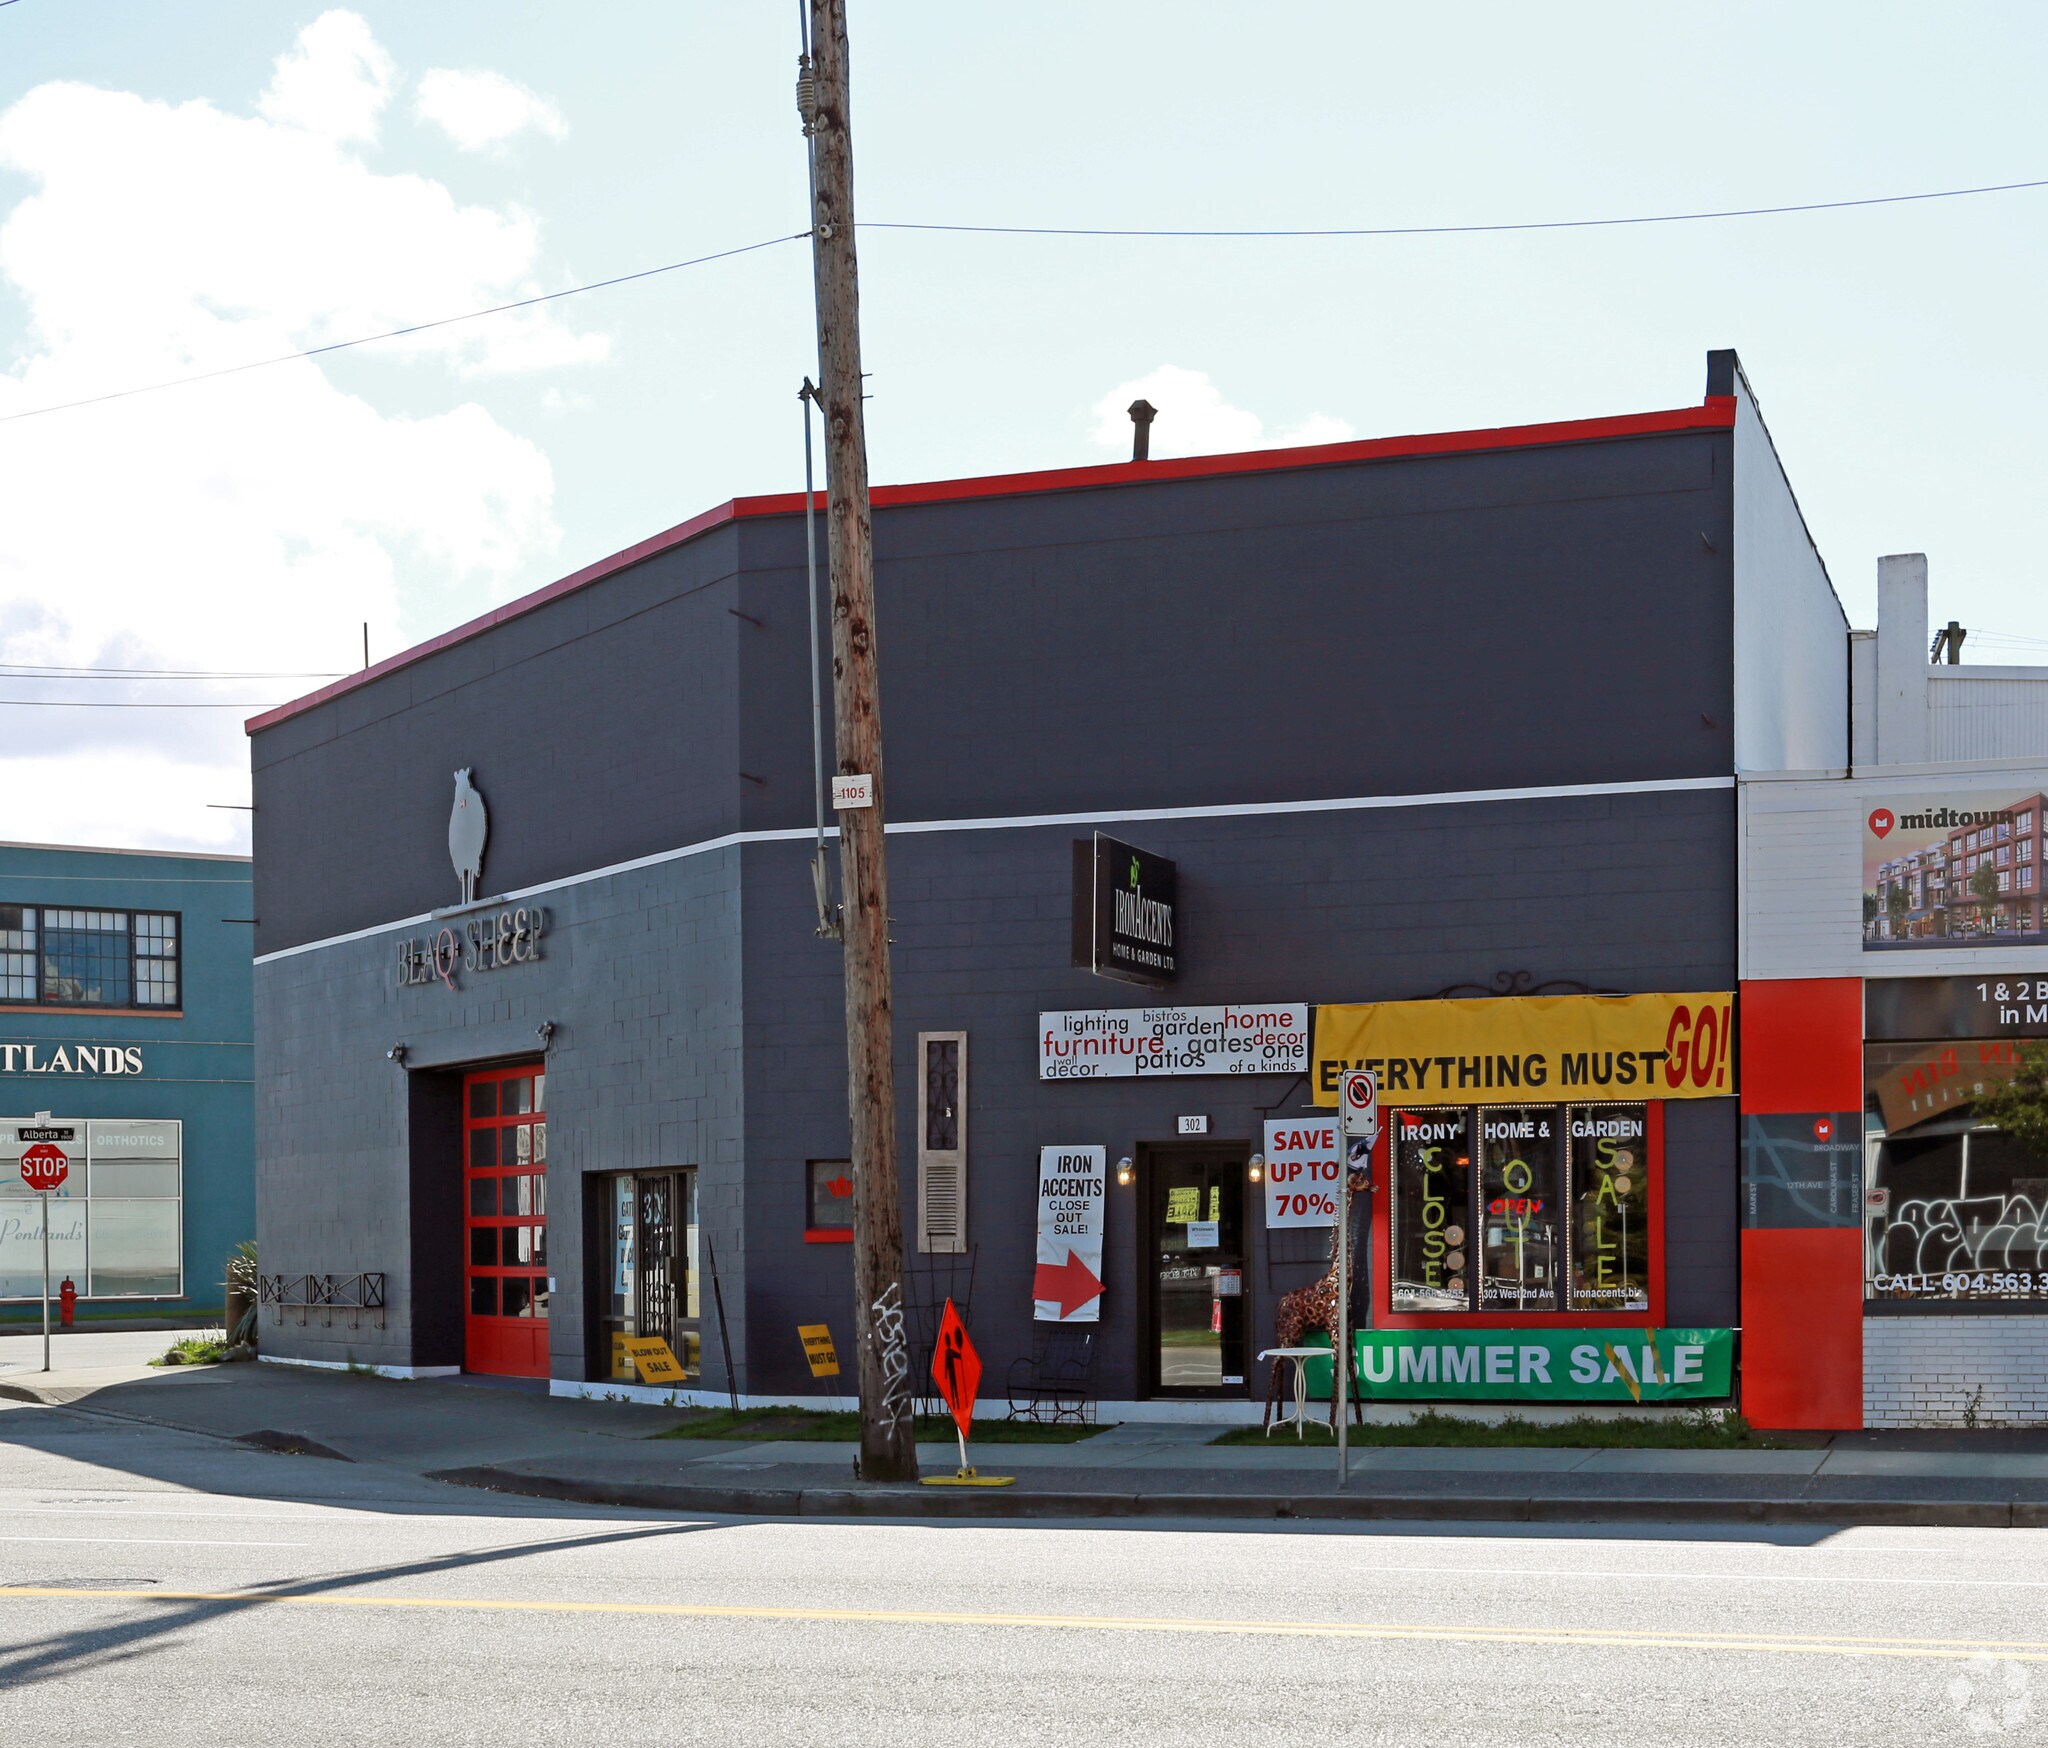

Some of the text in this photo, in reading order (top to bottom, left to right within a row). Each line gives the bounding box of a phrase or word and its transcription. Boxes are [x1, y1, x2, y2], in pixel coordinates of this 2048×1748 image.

[841, 787, 865, 799] 1105
[1900, 808, 2015, 829] midtown
[396, 905, 545, 991] BLAQ SHEEP
[1112, 942, 1130, 960] HOME
[1131, 949, 1136, 961] &
[1137, 950, 1162, 967] GARDEN
[1977, 983, 1987, 1002] 1
[1994, 982, 2010, 1001] &
[2017, 981, 2030, 1001] 2
[1142, 1010, 1187, 1023] bistros
[1224, 1007, 1294, 1029] home
[2000, 1005, 2019, 1024] in
[1063, 1015, 1129, 1034] lighting
[1152, 1016, 1225, 1041] garden
[1043, 1030, 1165, 1057] furniture
[1187, 1033, 1254, 1060] gates
[1253, 1028, 1307, 1047] decor
[1560, 1051, 1660, 1086] MUST
[1664, 1004, 1731, 1089] GO!
[1057, 1055, 1078, 1066] wall
[1135, 1046, 1206, 1075] patios
[1262, 1044, 1305, 1059] one
[1046, 1060, 1099, 1078] decor
[1229, 1058, 1297, 1073] of a kinds
[23, 1127, 59, 1140] Alberta
[1184, 1118, 1201, 1132] 302
[1401, 1120, 1643, 1141] IRONY HOME & GARDEN
[97, 1135, 165, 1146] ORTHOTICS
[1273, 1130, 1335, 1151] SAVE
[1814, 1143, 1860, 1152] BROADWAY
[22, 1157, 67, 1177] STOP
[1057, 1154, 1092, 1174] IRON
[1270, 1161, 1340, 1183] UP TO
[1041, 1178, 1102, 1197] ACCENTS
[1829, 1172, 1838, 1213] CAROLINA
[1049, 1200, 1090, 1211] CLOSE
[1275, 1193, 1336, 1217] 70%
[1749, 1192, 1757, 1215] MAIN
[1851, 1183, 1859, 1213] FRASER
[1056, 1212, 1082, 1223] OUT
[1594, 1138, 1620, 1289] SALE
[1054, 1224, 1088, 1235] SALE!
[1873, 1273, 1936, 1291] CALL
[1483, 1289, 1498, 1299] 302
[1500, 1288, 1520, 1299] West
[1522, 1288, 1537, 1299] 2nd
[1539, 1288, 1555, 1299] Ave
[1573, 1287, 1643, 1299] ironaccents.biz
[803, 1336, 832, 1347] EVERYTHING
[631, 1347, 668, 1357] BLOW OUT
[809, 1352, 836, 1365] MUST GO
[646, 1361, 672, 1373] SALE
[1569, 1344, 1705, 1384] SALE
